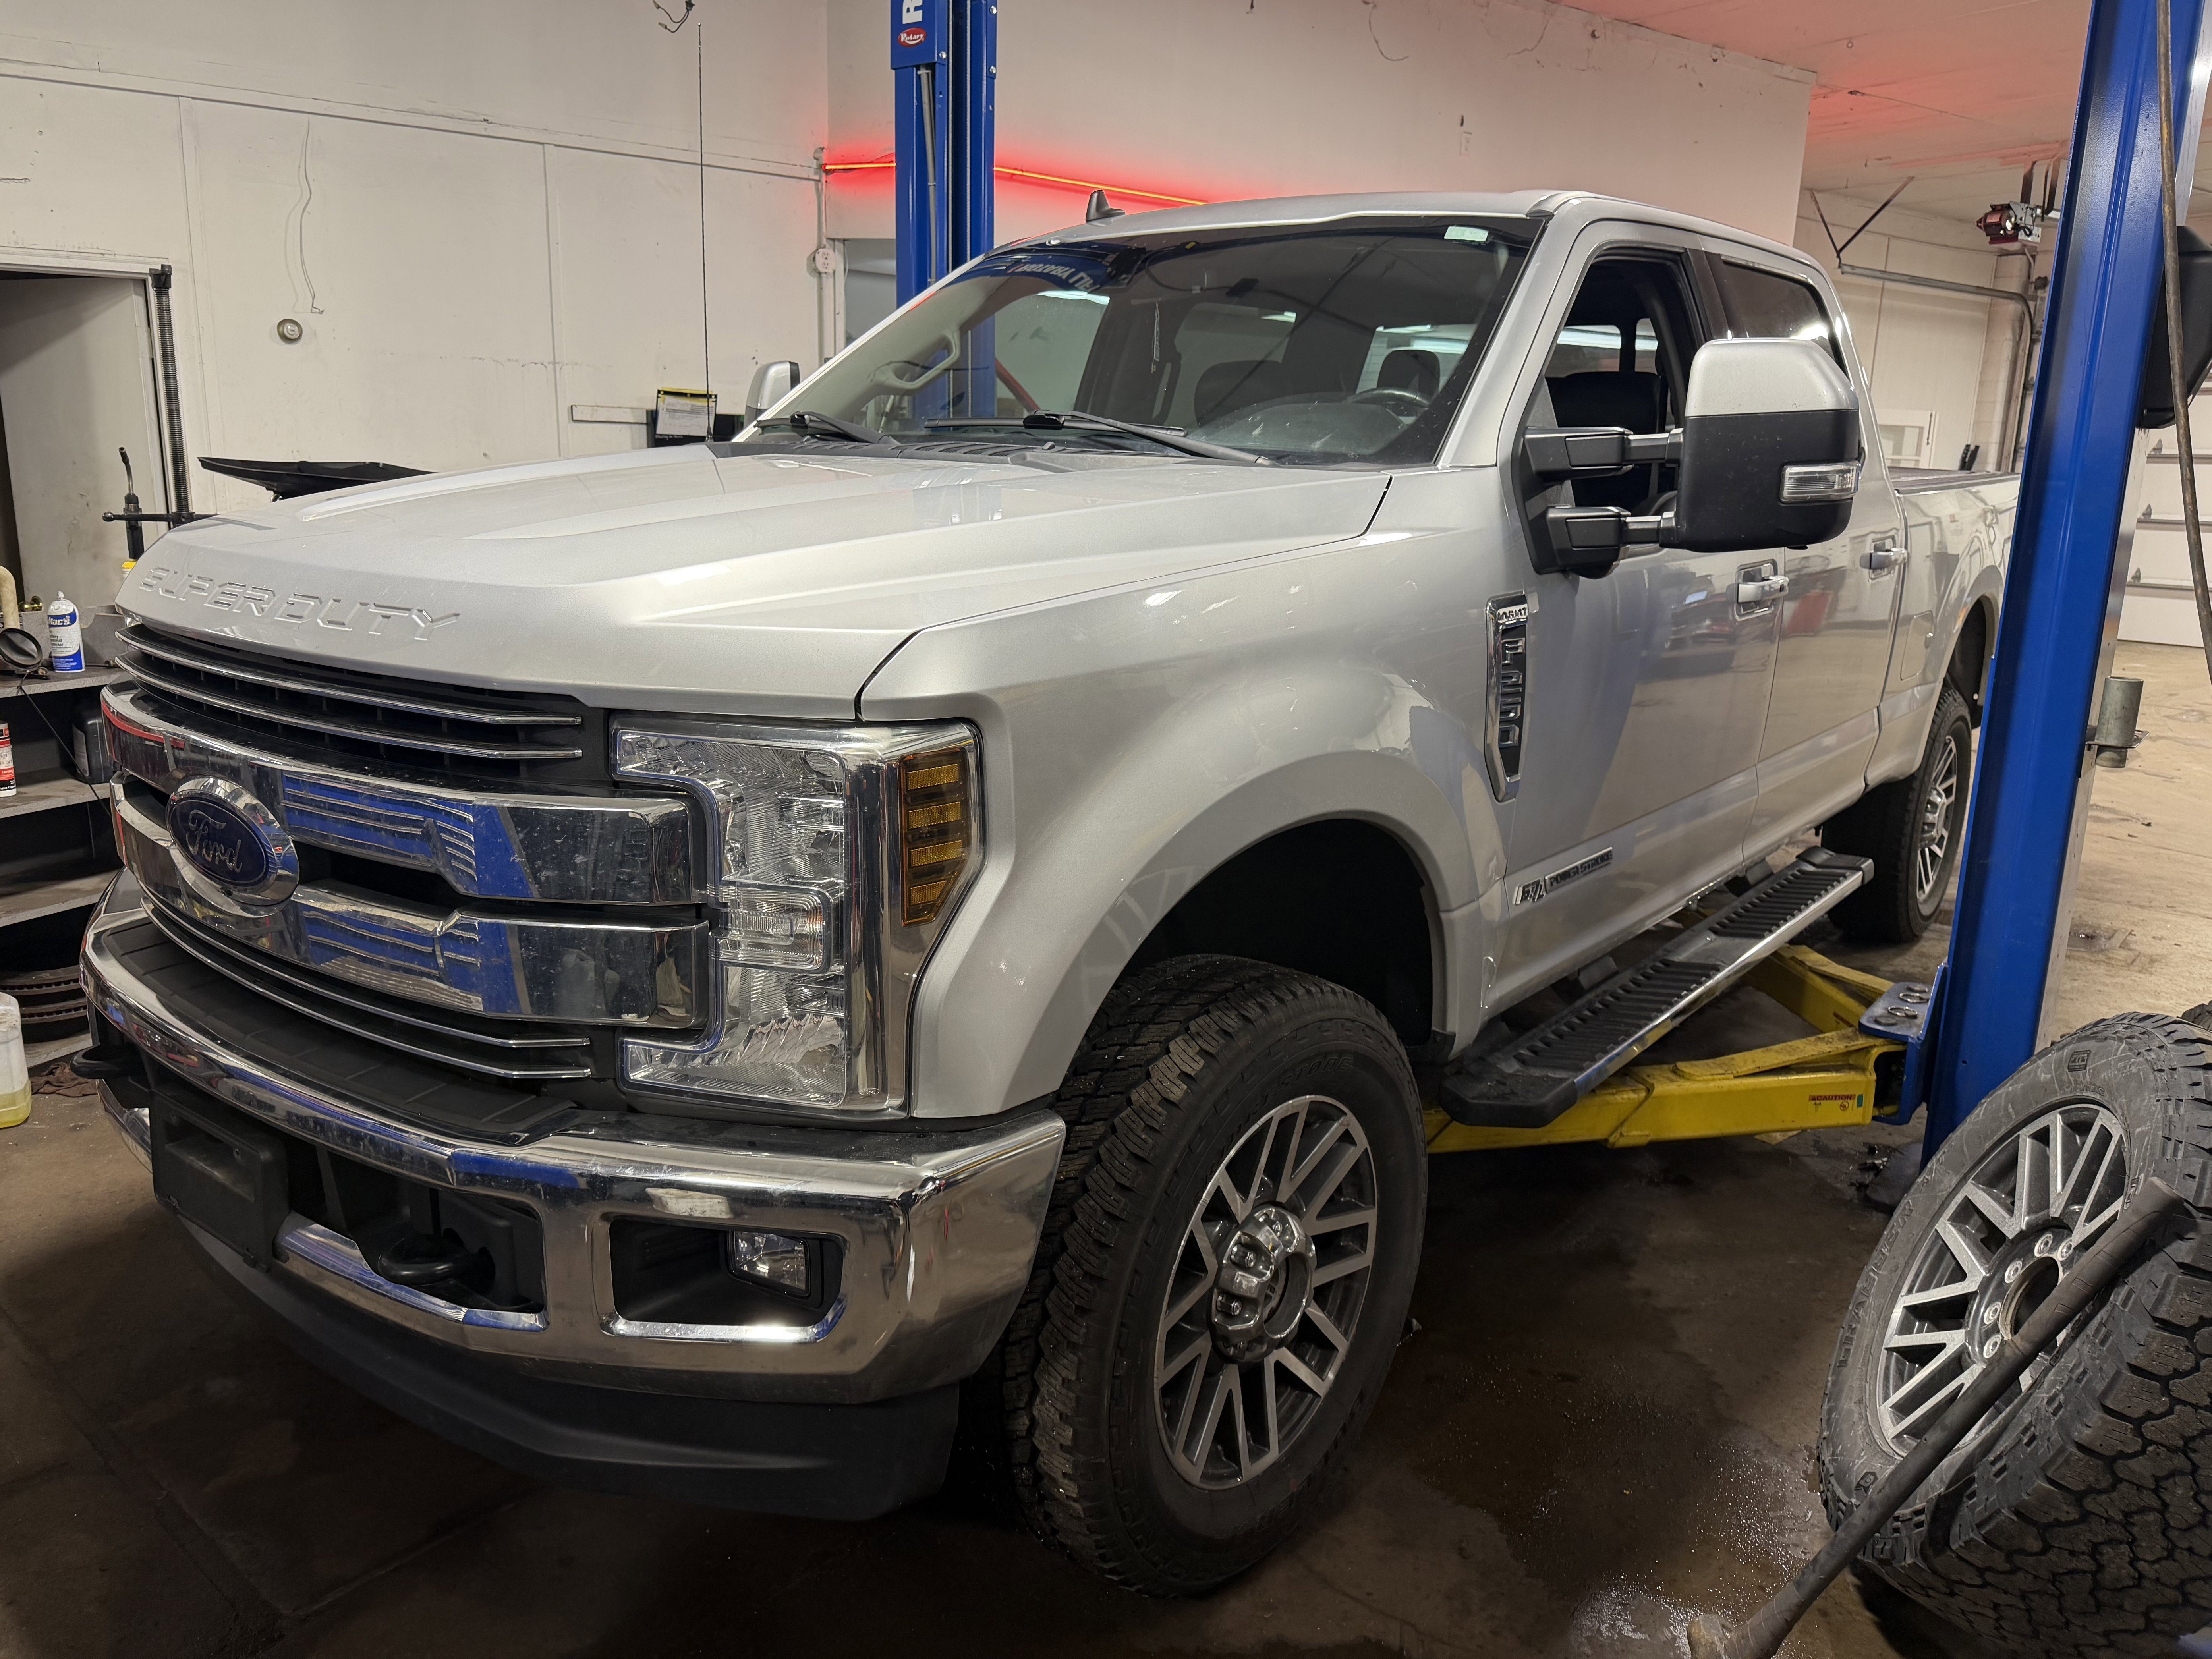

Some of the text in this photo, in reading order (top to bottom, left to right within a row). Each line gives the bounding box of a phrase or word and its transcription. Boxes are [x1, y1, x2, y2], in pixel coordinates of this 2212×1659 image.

[900, 33, 924, 44] Rotary
[139, 567, 461, 641] SUPER DUTY
[185, 809, 242, 873] Ford
